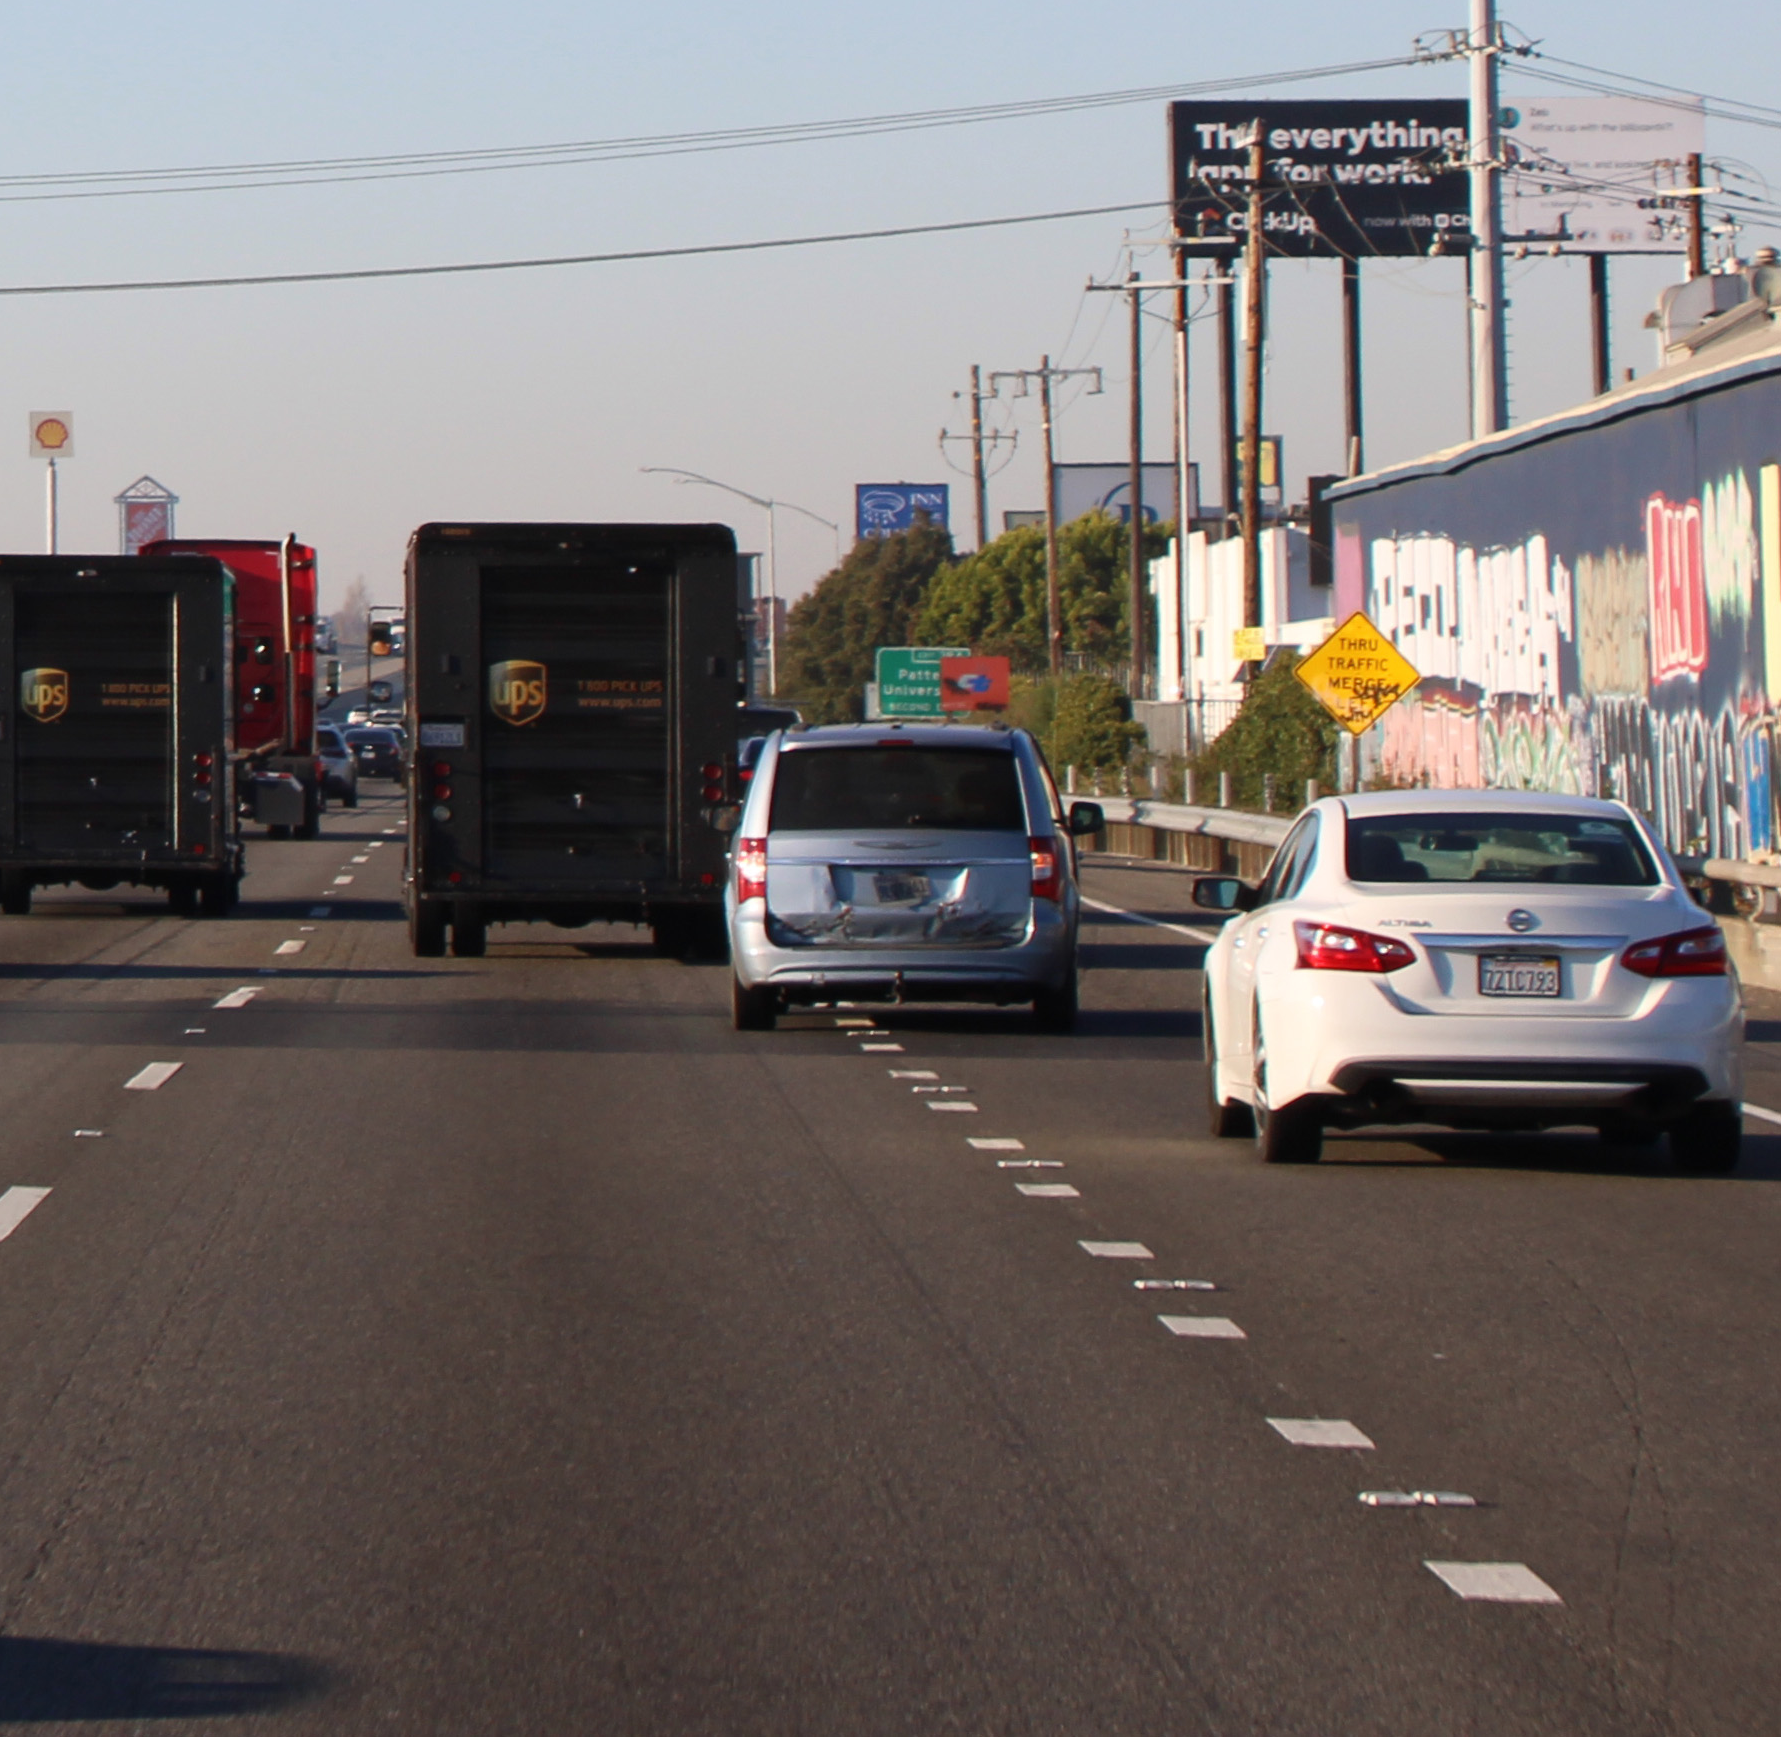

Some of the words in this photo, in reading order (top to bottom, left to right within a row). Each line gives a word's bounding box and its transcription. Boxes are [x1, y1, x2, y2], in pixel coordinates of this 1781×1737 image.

[1195, 122, 1255, 150] Th
[1269, 119, 1465, 156] everything
[1274, 157, 1329, 183] for
[1334, 158, 1432, 185] work.
[1226, 211, 1316, 235] ClkUp
[910, 492, 943, 505] INN
[1339, 637, 1378, 652] THRU
[1327, 657, 1389, 672] TRAFFIC
[898, 668, 940, 681] Patte
[587, 680, 609, 692] 800
[611, 680, 638, 693] PICK
[640, 680, 664, 693] UPS
[883, 684, 941, 696] Univers
[1328, 677, 1386, 691] MERGE
[26, 684, 65, 713] ups
[102, 698, 171, 708] www.ups.com
[496, 680, 543, 715] ups
[578, 697, 663, 709] www.ups.com
[1335, 695, 1375, 711] LEF
[1378, 919, 1433, 928] ALTIMA
